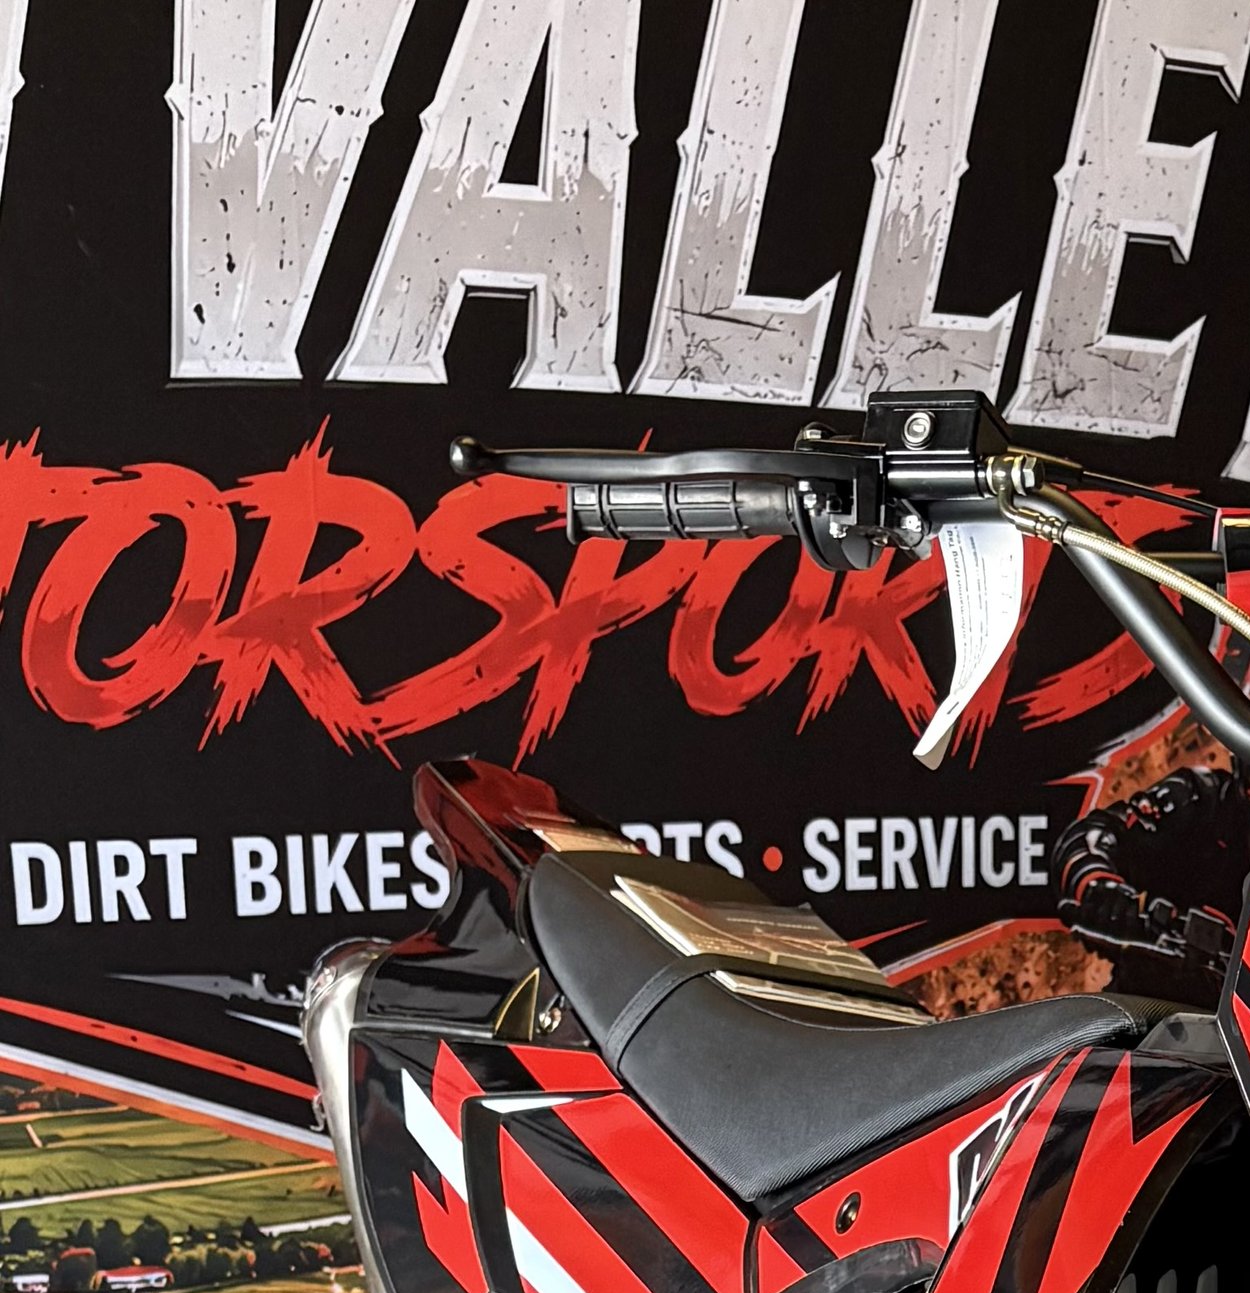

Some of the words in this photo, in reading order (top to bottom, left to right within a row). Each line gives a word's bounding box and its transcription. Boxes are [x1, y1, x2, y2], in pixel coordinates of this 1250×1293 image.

[10, 837, 198, 925] DIRT
[233, 829, 452, 918] BIKES
[803, 814, 1050, 893] SERVICE
